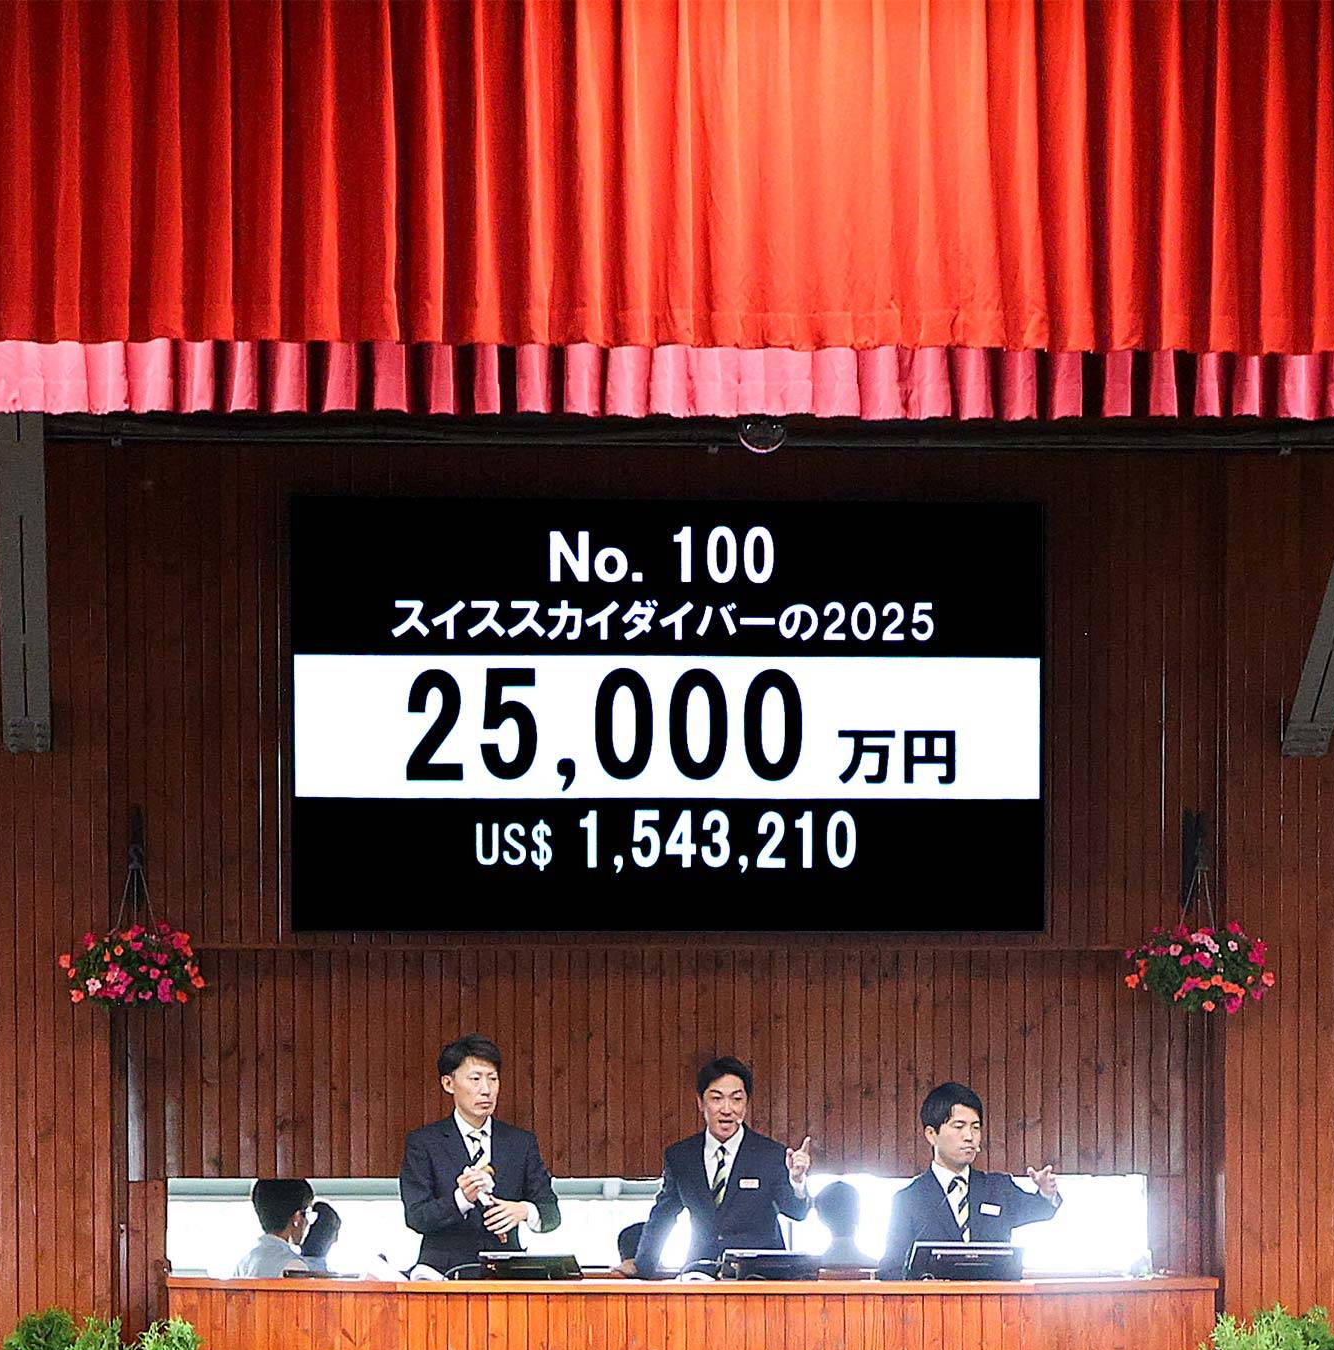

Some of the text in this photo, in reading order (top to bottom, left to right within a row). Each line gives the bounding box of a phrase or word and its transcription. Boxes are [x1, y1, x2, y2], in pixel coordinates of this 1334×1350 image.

[549, 525, 775, 584] No. 100
[391, 598, 935, 642] スイススカイダイバーの2025
[405, 667, 957, 792] 25,000 万円
[475, 809, 857, 874] US$ 1,543,210
